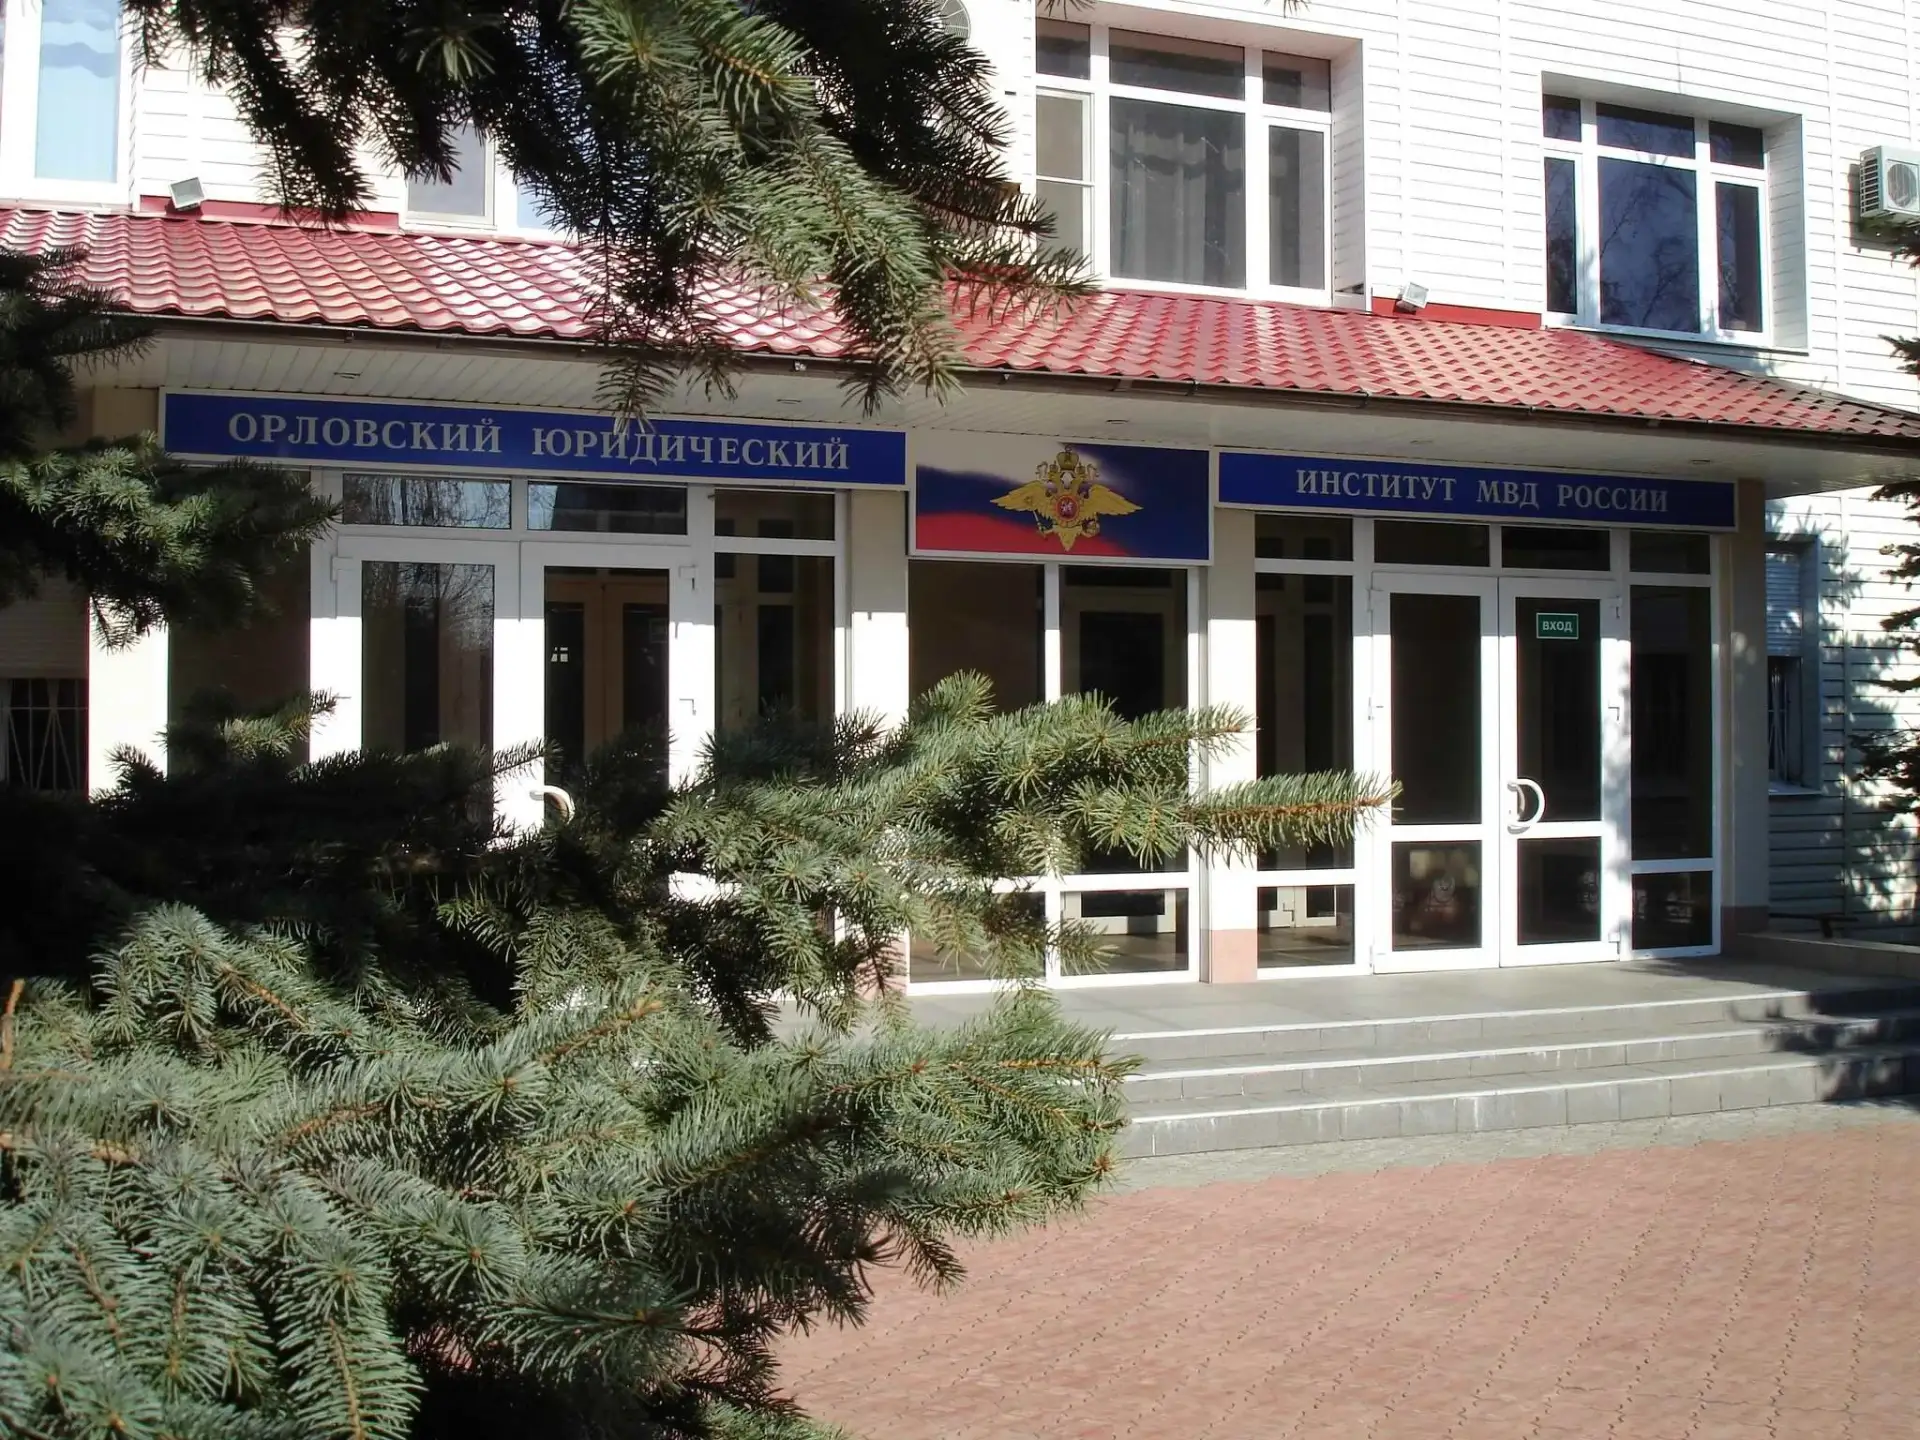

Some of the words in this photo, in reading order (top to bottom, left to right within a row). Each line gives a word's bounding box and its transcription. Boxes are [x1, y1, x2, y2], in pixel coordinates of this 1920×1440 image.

[229, 412, 502, 453] ОРЛОВСКИЙ
[531, 428, 850, 470] ЮРИДИЧЕСКИЙ
[1296, 470, 1457, 502] ИНСТИТУТ
[1476, 480, 1540, 509] МВД
[1556, 484, 1669, 513] РОССИИ
[1542, 620, 1573, 633] ВХОД
